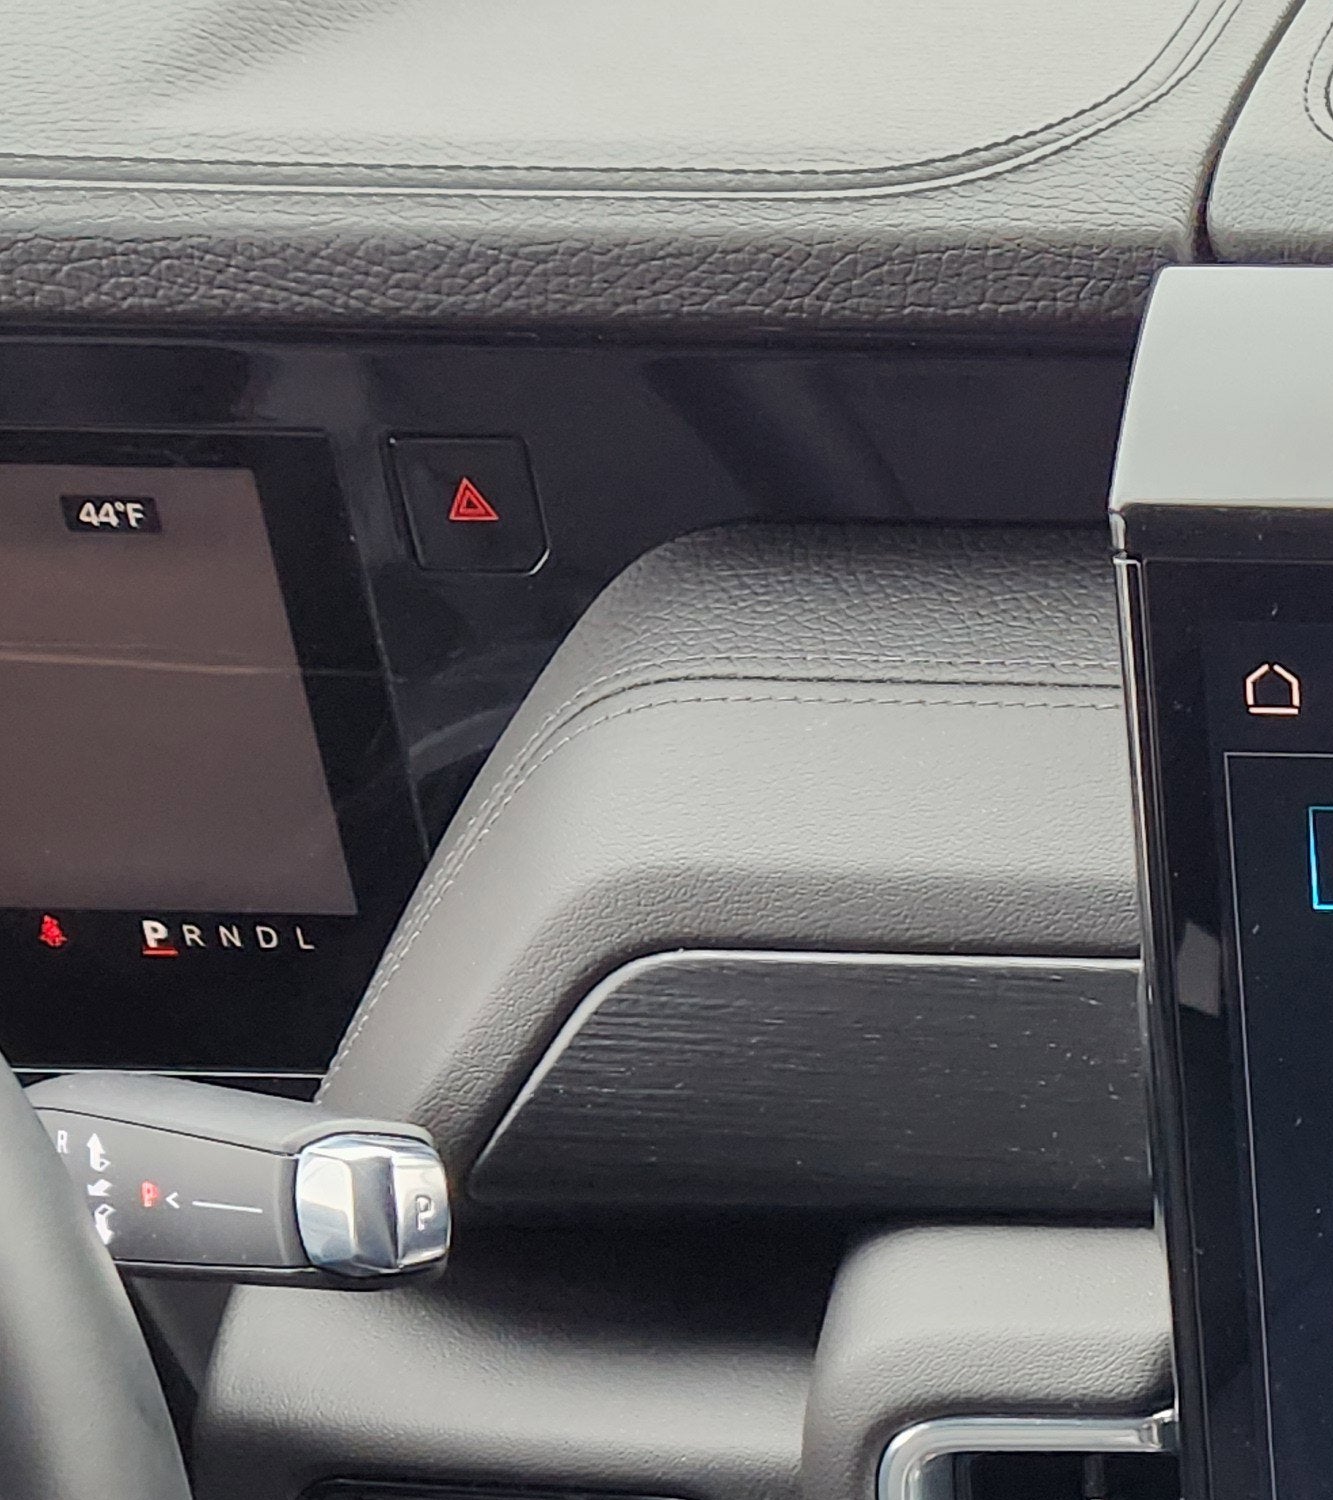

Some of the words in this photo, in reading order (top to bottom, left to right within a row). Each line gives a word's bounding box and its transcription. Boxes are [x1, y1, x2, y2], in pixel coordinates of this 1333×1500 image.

[78, 501, 144, 528] 44°F
[143, 920, 168, 945] P
[182, 924, 206, 948] R
[218, 925, 242, 948] N
[255, 926, 279, 949] D
[296, 927, 315, 951] L
